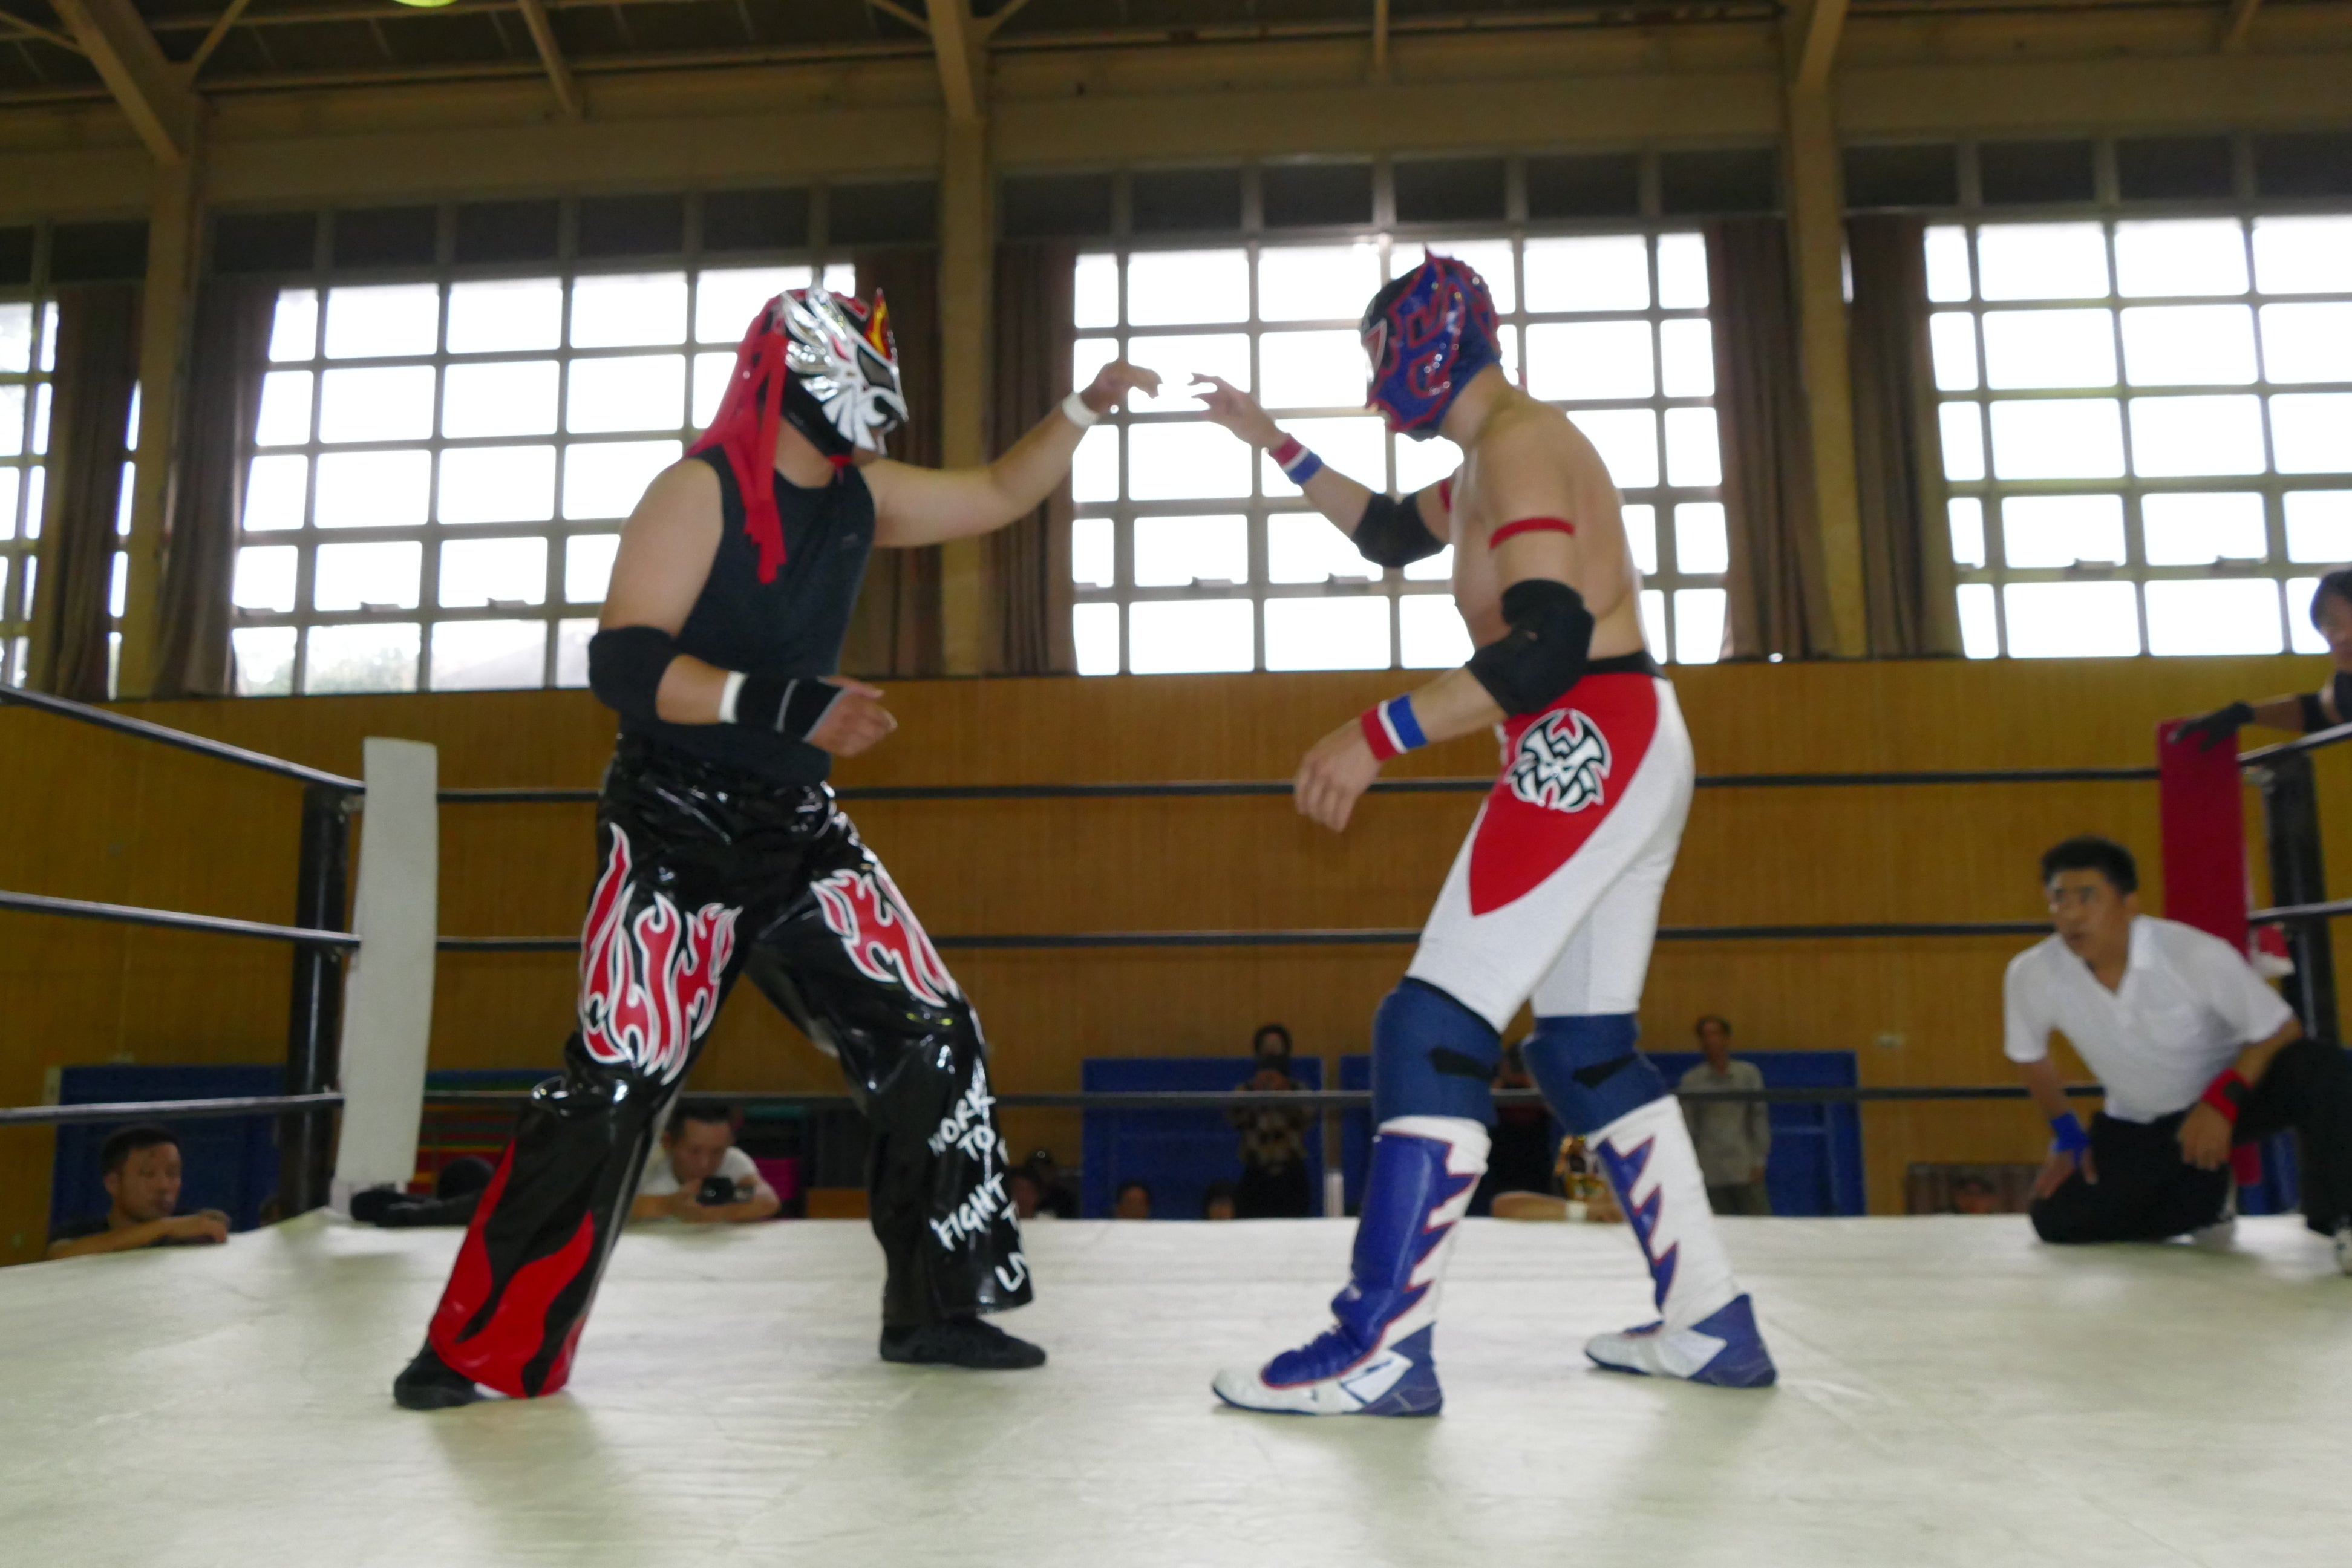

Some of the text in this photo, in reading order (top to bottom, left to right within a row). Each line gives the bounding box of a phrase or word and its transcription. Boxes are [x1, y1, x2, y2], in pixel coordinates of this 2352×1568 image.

[928, 1080, 996, 1157] WORK
[956, 1124, 996, 1161] TO
[929, 1172, 1008, 1252] FIGHT
